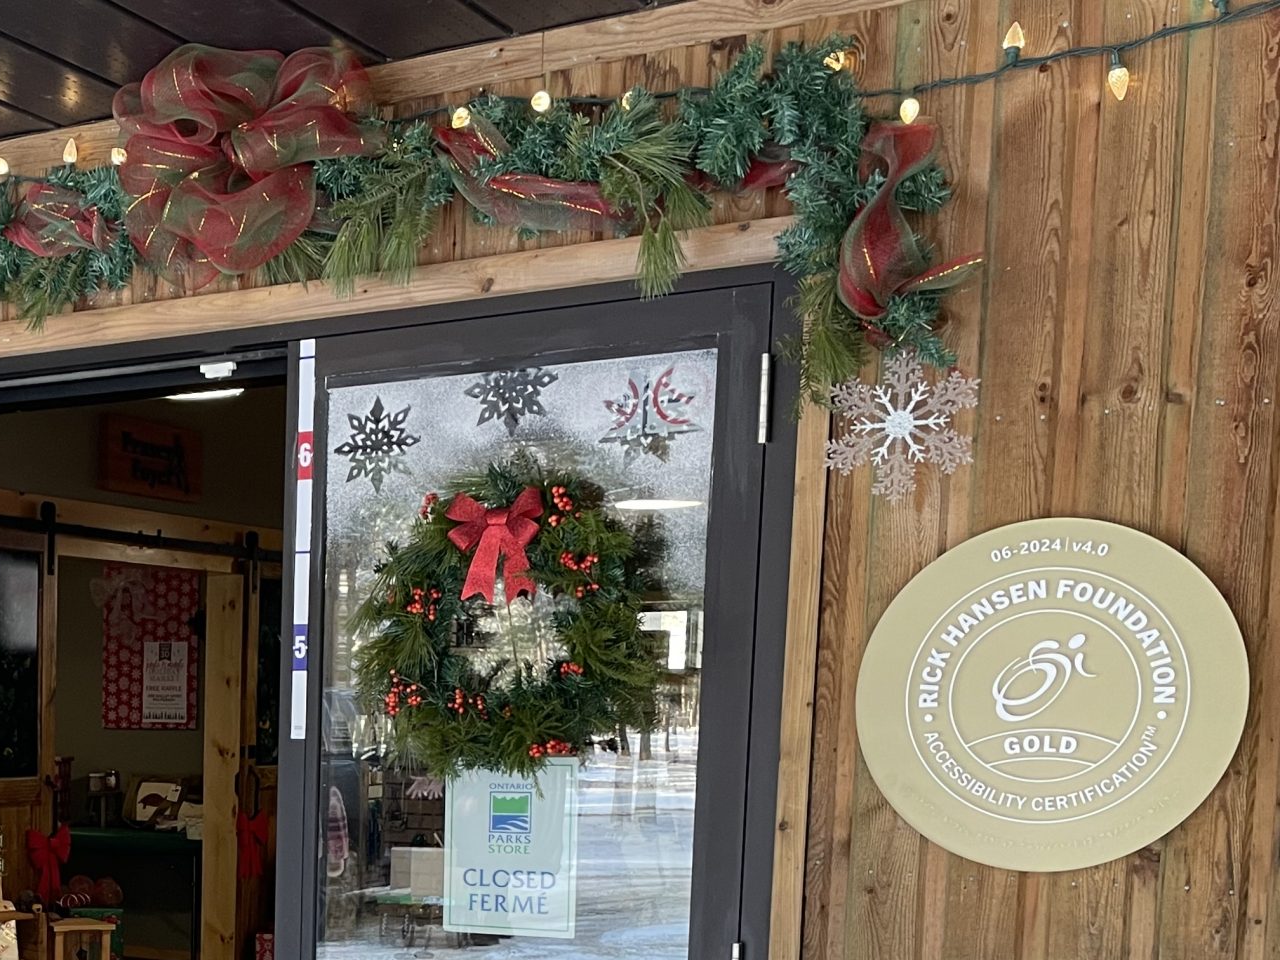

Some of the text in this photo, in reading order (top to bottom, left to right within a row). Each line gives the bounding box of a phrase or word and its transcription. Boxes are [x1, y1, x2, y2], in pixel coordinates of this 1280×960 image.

[300, 442, 311, 467] 6
[990, 538, 1109, 563] 06-2024 v4.0
[294, 635, 306, 658] 5
[918, 579, 1176, 709] RICK HANSEN FOUNDATION
[1004, 735, 1078, 754] GOLD
[924, 730, 1027, 810] ACCESSIBILITY
[489, 782, 533, 790] ONTARIO
[488, 834, 531, 844] PARKS
[488, 845, 531, 855] STORE
[463, 868, 556, 890] CLOSED
[469, 892, 549, 915] FERMÉ
